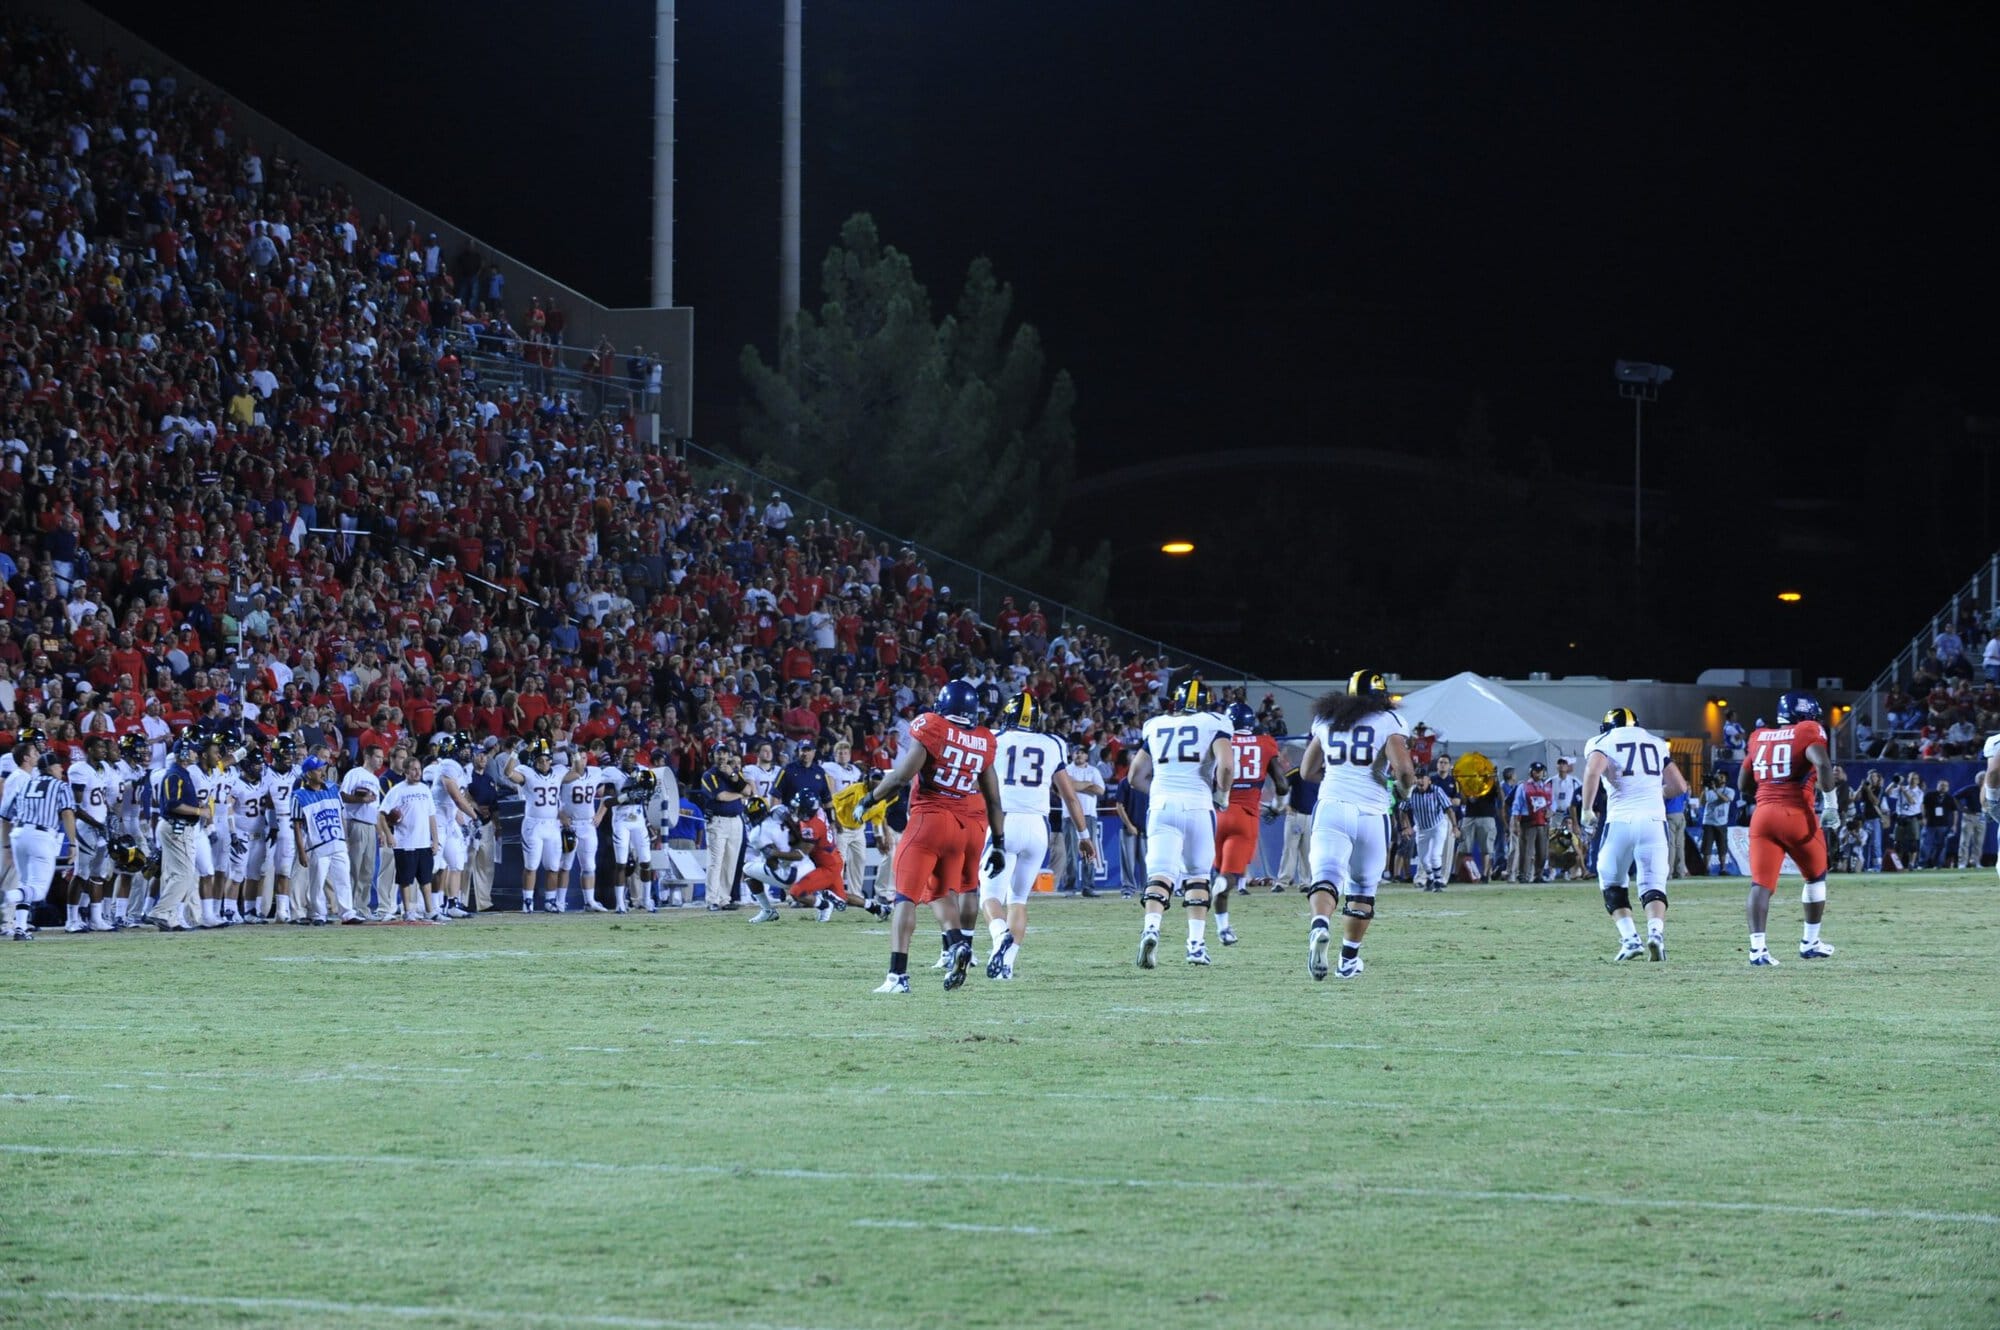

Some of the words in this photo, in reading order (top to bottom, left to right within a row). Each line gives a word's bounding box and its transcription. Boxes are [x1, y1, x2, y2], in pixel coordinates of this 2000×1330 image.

[1157, 725, 1200, 764] 72
[1327, 725, 1376, 766] 58
[1615, 742, 1661, 777] 70
[1752, 743, 1792, 780] 49
[932, 744, 984, 792] 33
[1003, 744, 1045, 788] 13
[534, 787, 559, 807] 33
[572, 786, 595, 805] 68
[317, 817, 341, 831] PAC
